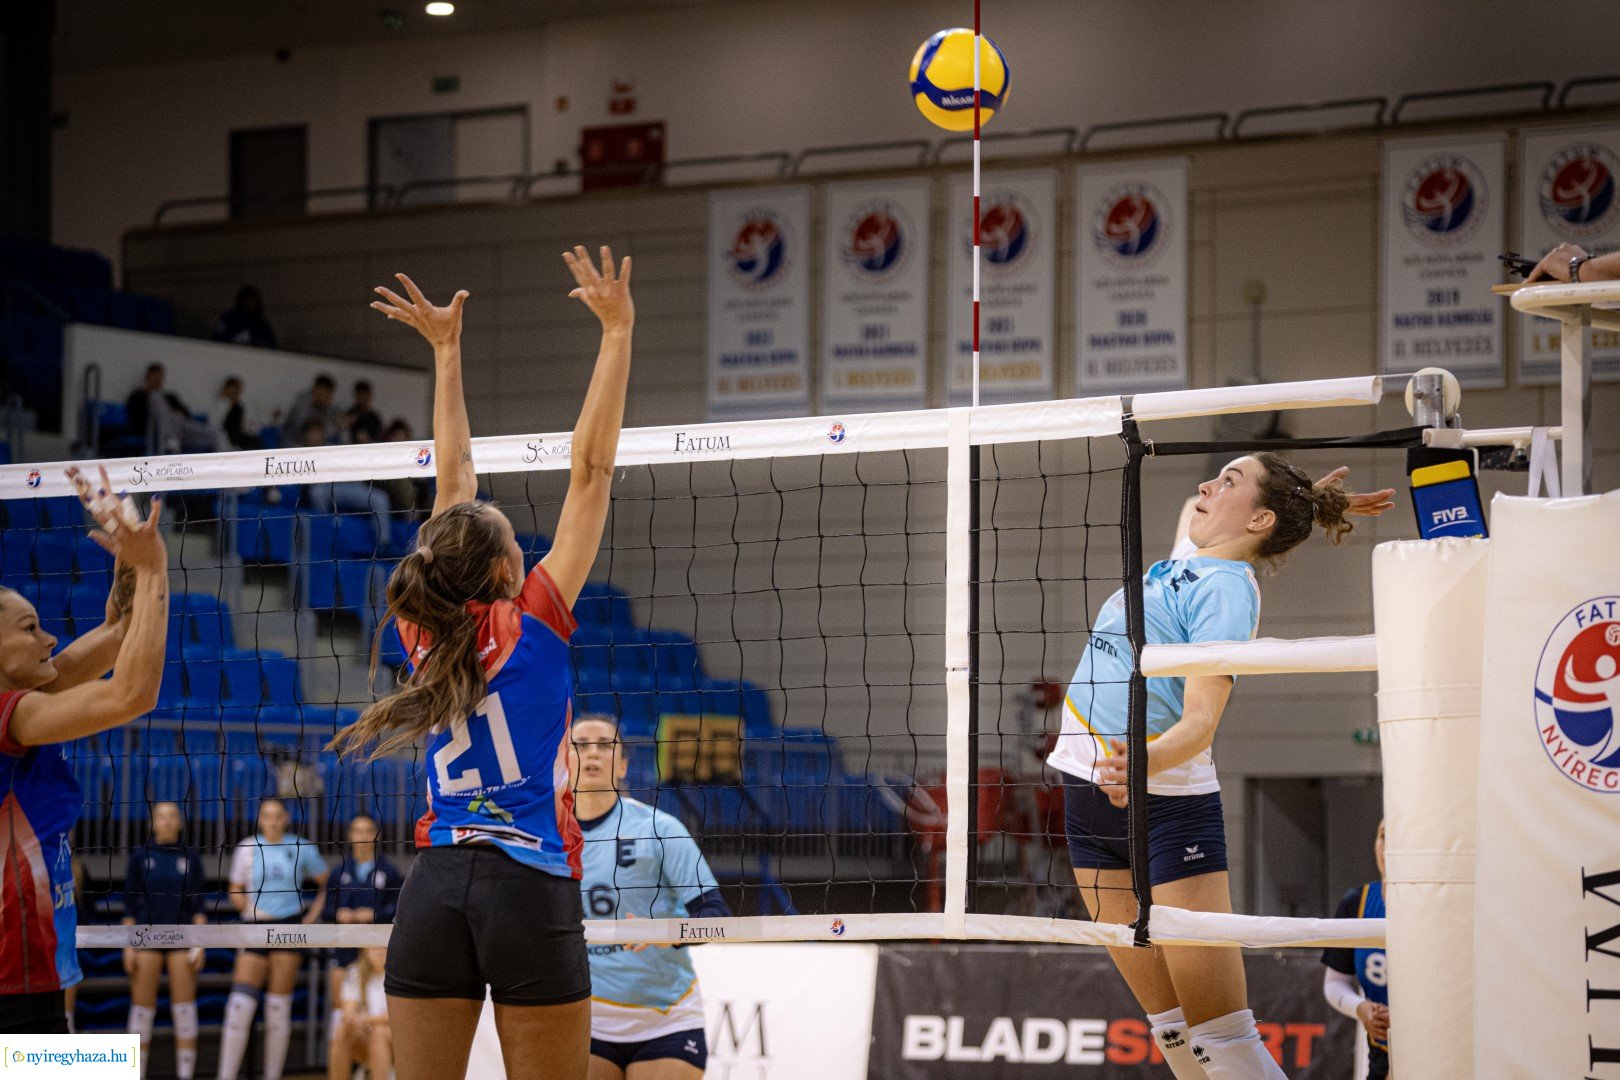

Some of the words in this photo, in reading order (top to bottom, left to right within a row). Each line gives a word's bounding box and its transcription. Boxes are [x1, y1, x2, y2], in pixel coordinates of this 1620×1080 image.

[675, 432, 729, 451] FATUM
[265, 457, 315, 474] FATUM
[1432, 506, 1467, 524] FIVB
[434, 691, 522, 795] 21
[266, 928, 307, 944] FATUM
[679, 922, 725, 939] FATUM
